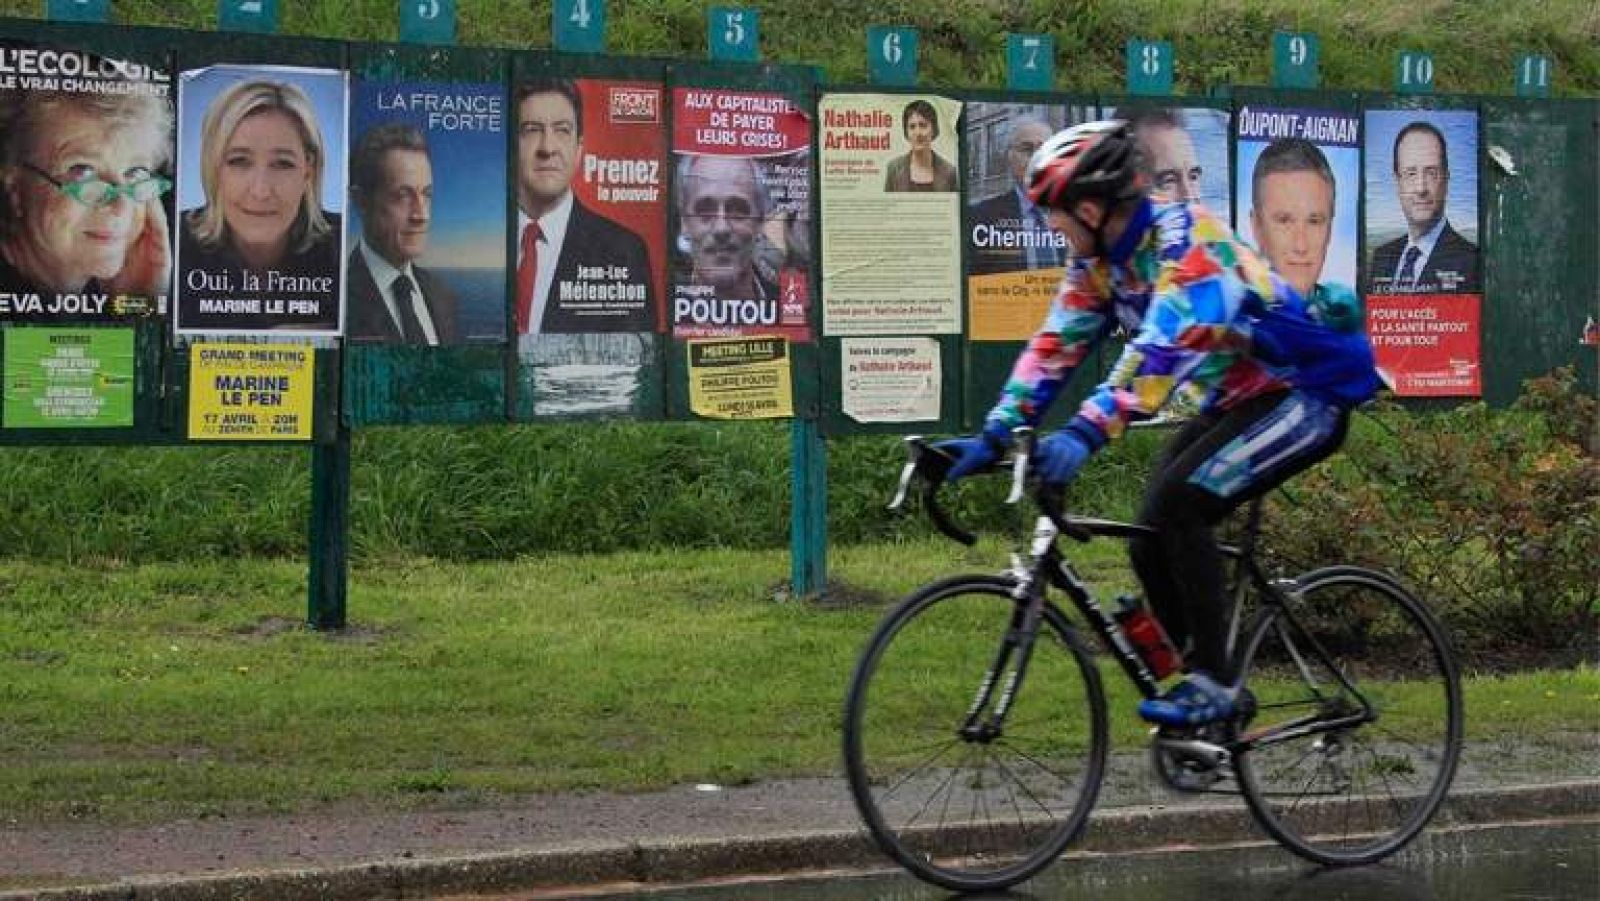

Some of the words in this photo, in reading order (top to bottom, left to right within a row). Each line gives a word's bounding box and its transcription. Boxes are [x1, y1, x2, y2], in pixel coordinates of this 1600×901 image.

[568, 0, 591, 28] 4
[724, 12, 745, 45] 5
[882, 32, 902, 64] 6
[1023, 38, 1040, 69] 7
[1289, 36, 1307, 66] 9
[1142, 45, 1159, 76] 8
[1402, 54, 1433, 85] 10
[1523, 56, 1548, 87] 11
[0, 75, 17, 89] LE
[20, 76, 59, 91] VRAI
[62, 78, 170, 96] CHANGEMENT
[377, 92, 406, 111] LA
[410, 93, 501, 113] FRANCE
[685, 93, 713, 109] AUX
[428, 113, 501, 132] FORTE
[710, 112, 729, 127] DE
[732, 114, 775, 130] PAYER
[824, 109, 893, 128] Nathalie
[1239, 106, 1359, 142] DUPONT-AIGNAN
[697, 129, 737, 144] LEURS
[824, 131, 891, 150] Arthaud
[584, 154, 659, 184] Prenez
[973, 224, 1066, 248] Chemina
[187, 269, 234, 293] Oui,
[243, 269, 259, 291] la
[267, 271, 332, 293] France
[577, 265, 629, 279] Jean-Luc
[0, 294, 43, 314] EVA
[48, 294, 107, 314] JOLY
[200, 300, 260, 314] MARINE
[265, 300, 284, 314] LE
[287, 300, 319, 315] PEN
[674, 298, 777, 324] POUTOU
[1381, 322, 1394, 332] LA
[200, 350, 244, 360] GRAND
[249, 351, 306, 362] MEETING
[702, 344, 746, 357] MEETING
[216, 376, 289, 391] MARINE
[221, 391, 242, 405] LE
[247, 392, 282, 407] PEN
[222, 413, 257, 424] AVRIL
